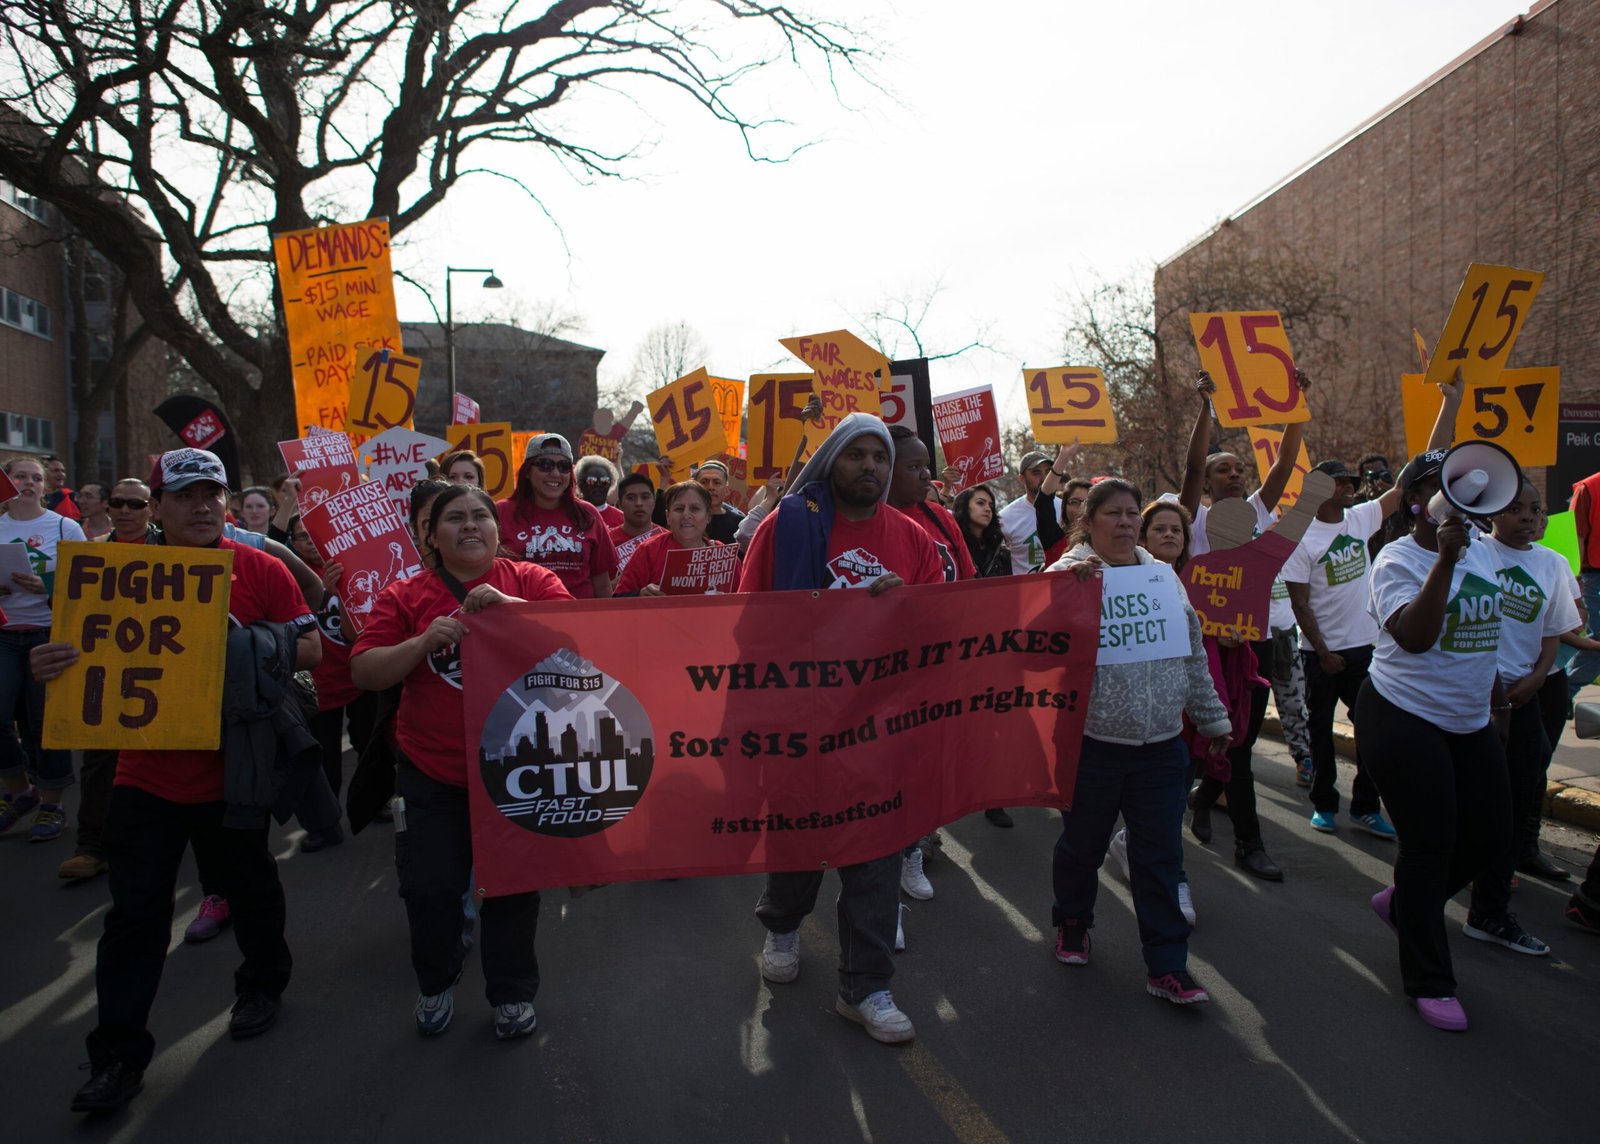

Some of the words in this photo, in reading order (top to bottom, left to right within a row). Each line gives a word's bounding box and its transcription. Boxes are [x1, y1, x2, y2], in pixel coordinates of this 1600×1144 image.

[286, 224, 388, 273] DEMANDS:
[304, 279, 339, 306] $15
[316, 300, 370, 322] WAGE
[1448, 280, 1533, 360] 15
[799, 338, 844, 366] FAIR
[314, 360, 355, 388] DAY
[1200, 315, 1299, 420] 15
[352, 351, 419, 430] 15
[818, 368, 875, 392] WAGES
[1030, 371, 1100, 413] 15
[821, 391, 861, 413] FOR
[934, 400, 963, 418] RAISE
[963, 394, 983, 410] THE
[654, 381, 711, 450] 15
[937, 408, 982, 431] MINIMUM
[301, 433, 346, 449] BECAUSE
[940, 426, 968, 444] WAGE
[1566, 431, 1590, 446] Peik
[294, 456, 328, 471] WON'T
[328, 452, 354, 467] WAIT
[301, 447, 325, 459] THE
[323, 443, 350, 456] RENT
[373, 442, 427, 466] #WE
[982, 452, 1002, 470] 15
[385, 470, 418, 493] ARE
[325, 481, 386, 518] BECAUSE
[329, 509, 359, 534] THE
[356, 498, 392, 523] RENT
[324, 525, 367, 558] WON'T
[365, 513, 401, 538] WAIT
[618, 542, 637, 558] AISE
[691, 545, 738, 563] BECAUSE
[1328, 541, 1362, 567] NOC
[687, 562, 708, 576] THE
[709, 558, 736, 574] RENT
[838, 559, 854, 571] FIGHT
[854, 562, 867, 573] FOR
[867, 564, 882, 575] $15
[67, 554, 225, 605] FIGHT
[671, 575, 705, 588] WON'T
[708, 571, 733, 587] WAIT
[1498, 573, 1539, 602] NOC
[1152, 598, 1161, 611] &
[1208, 588, 1228, 608] to
[82, 614, 186, 656] FOR
[1099, 619, 1166, 648] ESPECT
[686, 649, 910, 692] WHATEVER
[918, 641, 952, 668] IT
[958, 629, 1072, 660] TAKES
[527, 674, 557, 690] FIGHT
[559, 676, 580, 689] FOR
[582, 677, 601, 690] $15
[82, 666, 164, 729] 15
[669, 731, 730, 758] for
[740, 730, 809, 759] $15
[818, 715, 877, 754] and
[886, 701, 963, 735] union
[969, 686, 1078, 713] rights!
[505, 759, 639, 800] CTUL
[535, 796, 591, 813] FAST
[711, 790, 904, 834] #strikefastfood
[538, 809, 602, 827] FOOD
